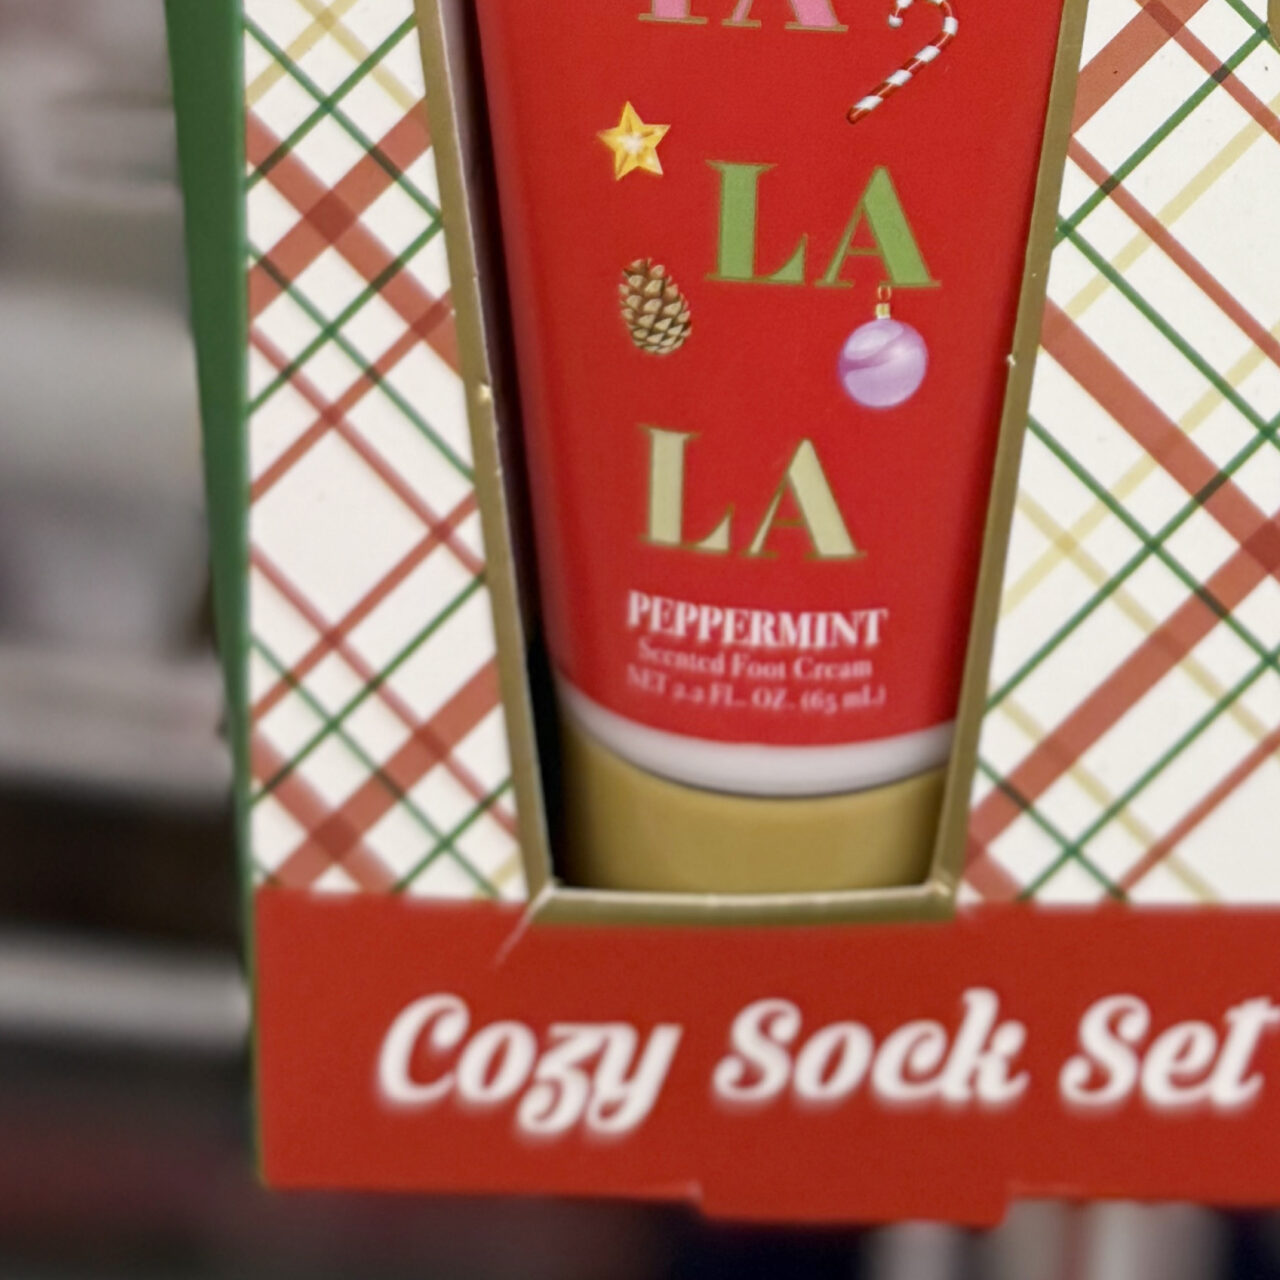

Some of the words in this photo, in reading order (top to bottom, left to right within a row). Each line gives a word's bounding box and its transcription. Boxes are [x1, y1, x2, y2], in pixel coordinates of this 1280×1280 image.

[705, 160, 942, 289] LA
[637, 424, 867, 560] LA
[626, 589, 890, 649] PEPPERMINT
[637, 636, 726, 677] Scented
[730, 652, 787, 680] Foot
[793, 656, 874, 683] Cream
[626, 663, 668, 695] NET
[373, 992, 684, 1138] Cozy
[710, 987, 1030, 1106] Sock
